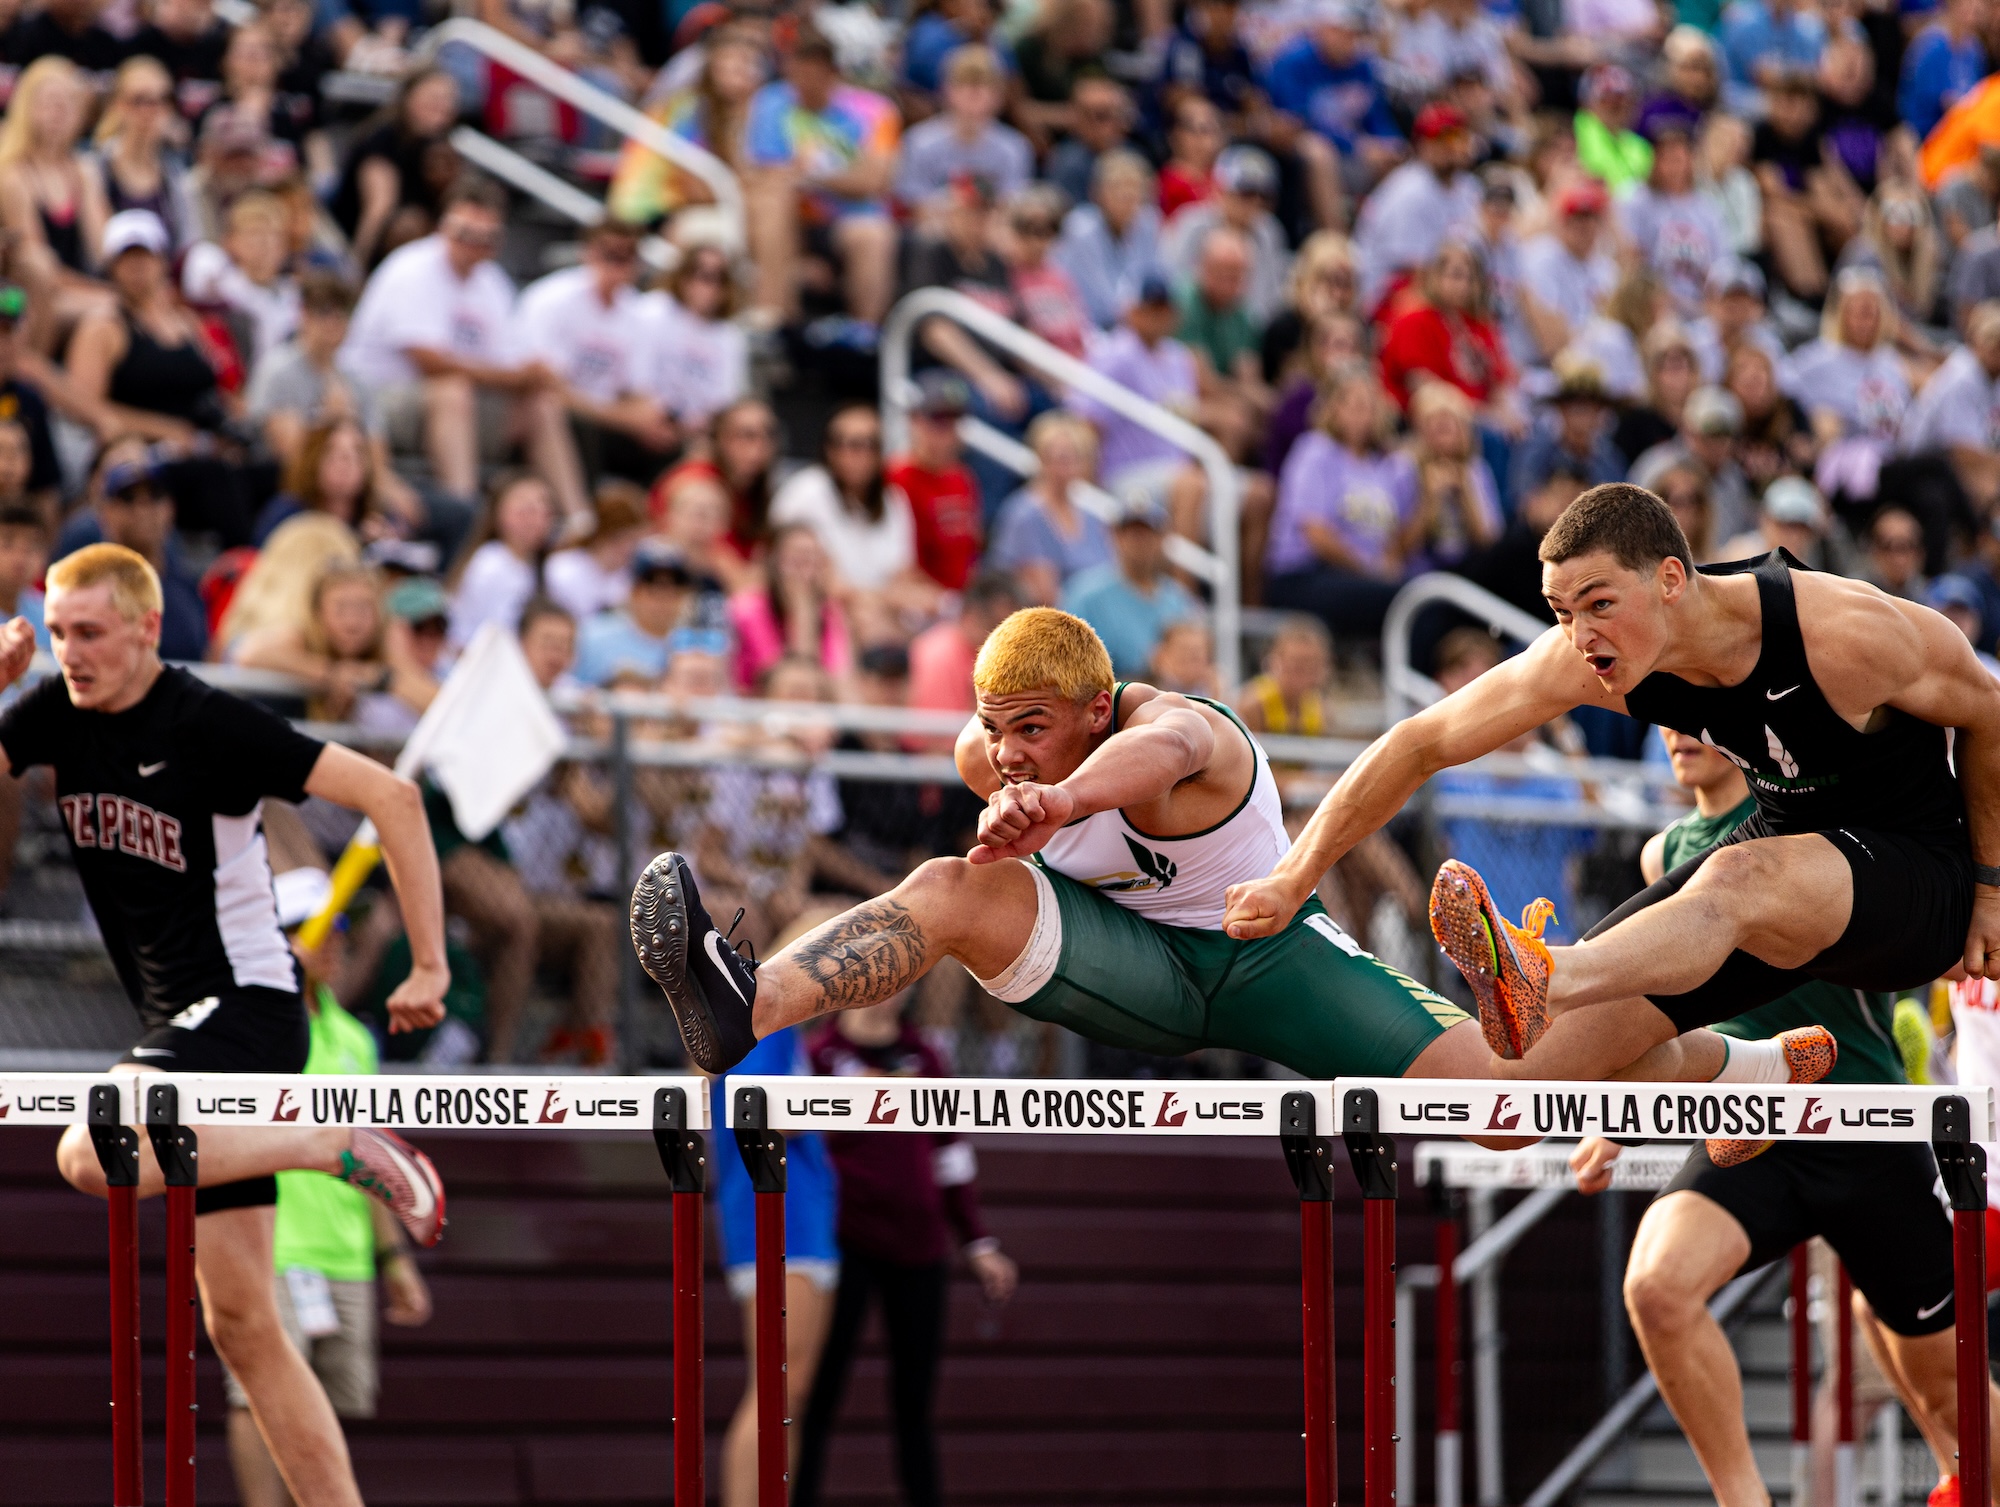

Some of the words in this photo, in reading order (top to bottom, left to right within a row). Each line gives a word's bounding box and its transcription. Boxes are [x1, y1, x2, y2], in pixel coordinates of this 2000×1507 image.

[1756, 777, 1779, 792] TRACK
[97, 793, 187, 873] PERE
[17, 1096, 76, 1112] UCS
[197, 1097, 257, 1114] UCS
[312, 1088, 405, 1124] UW-LA
[414, 1087, 529, 1125] CROSSE
[575, 1099, 639, 1117] UCS
[786, 1098, 852, 1117] UCS
[910, 1088, 1011, 1127] UW-LA
[1021, 1088, 1146, 1129] CROSSE
[1195, 1101, 1264, 1120] UCS
[1400, 1103, 1472, 1122] UCS
[1533, 1093, 1642, 1133] UW-LA
[1652, 1093, 1787, 1136] CROSSE
[1840, 1108, 1917, 1128] UCS
